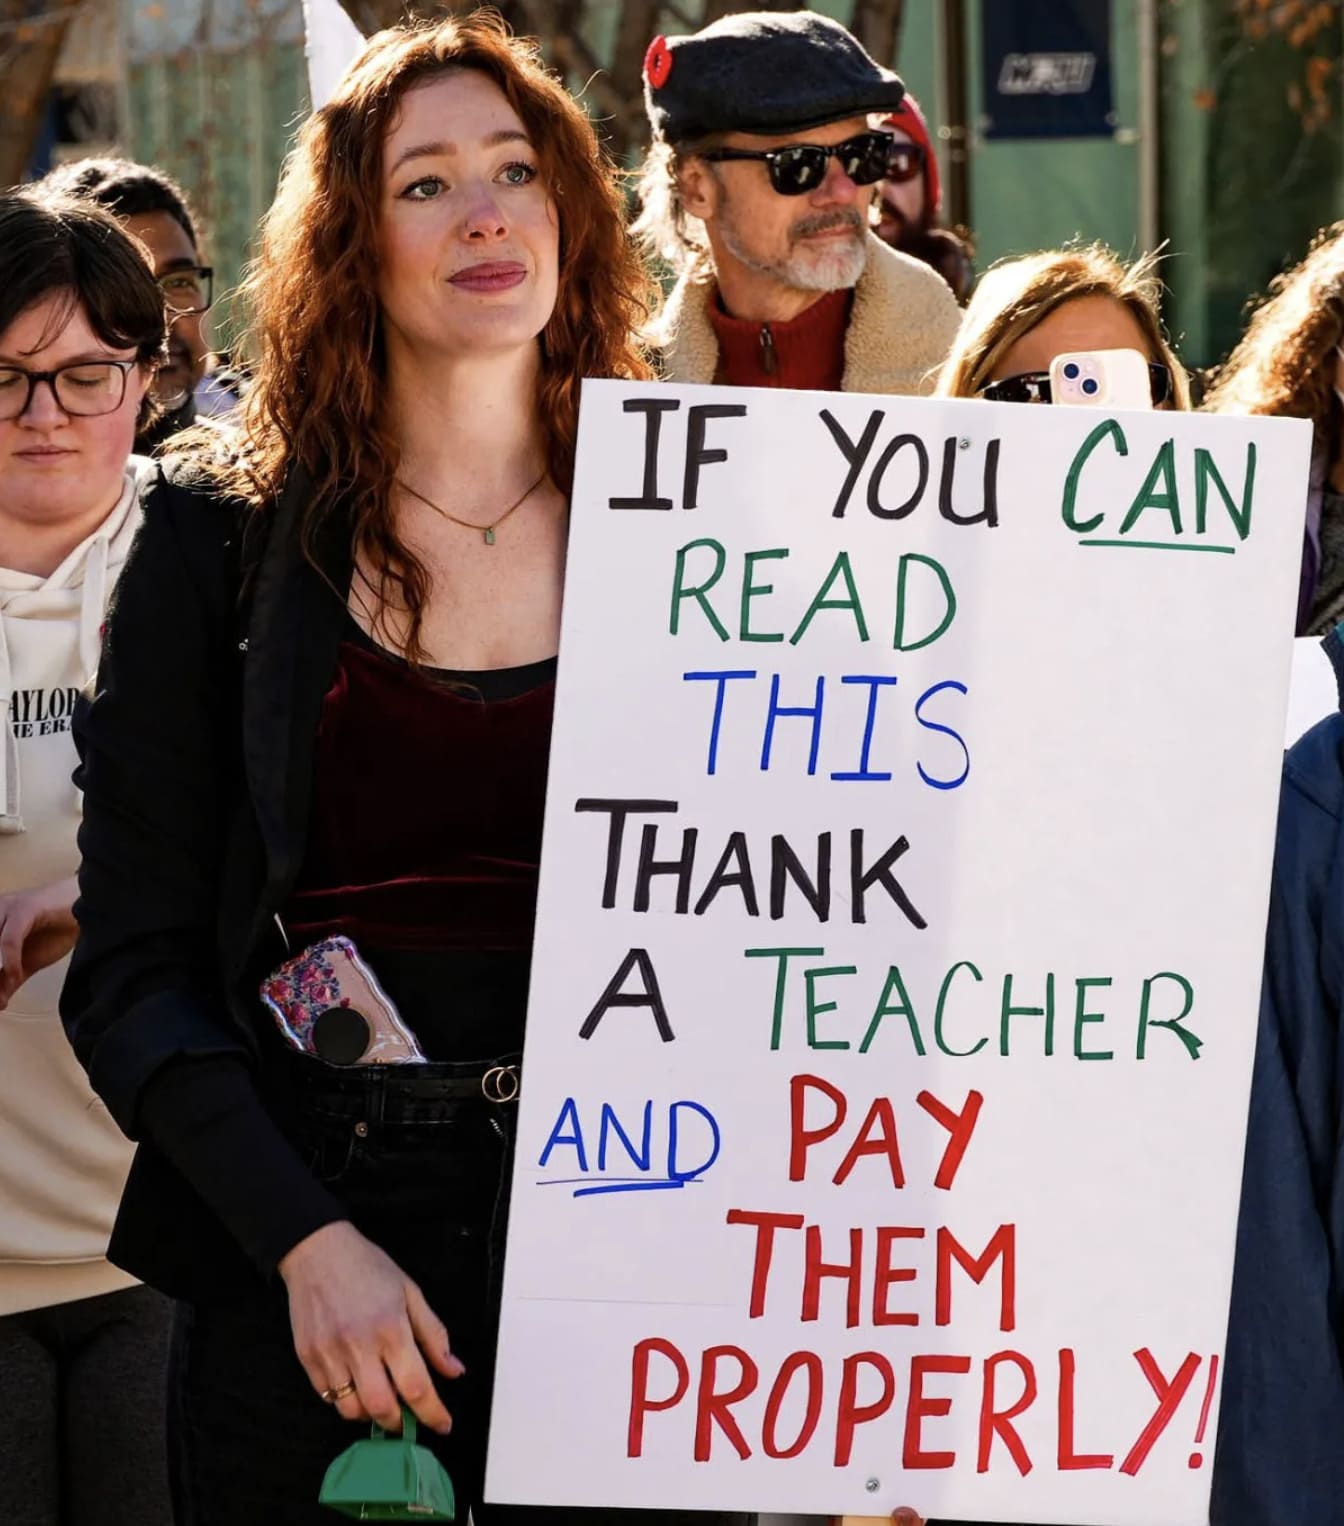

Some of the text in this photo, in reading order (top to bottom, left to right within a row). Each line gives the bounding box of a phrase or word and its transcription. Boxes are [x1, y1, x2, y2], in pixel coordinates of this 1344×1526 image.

[609, 399, 1257, 541] IF YOU CAN
[670, 538, 957, 653] READ
[39, 719, 70, 736] ER
[684, 671, 971, 791] THIS
[575, 798, 928, 930] THANK
[579, 948, 1204, 1061] A TEACHER
[538, 1073, 984, 1191] AND PAY
[727, 1209, 1017, 1333] THEM
[628, 1338, 1219, 1478] PROPERLY!
